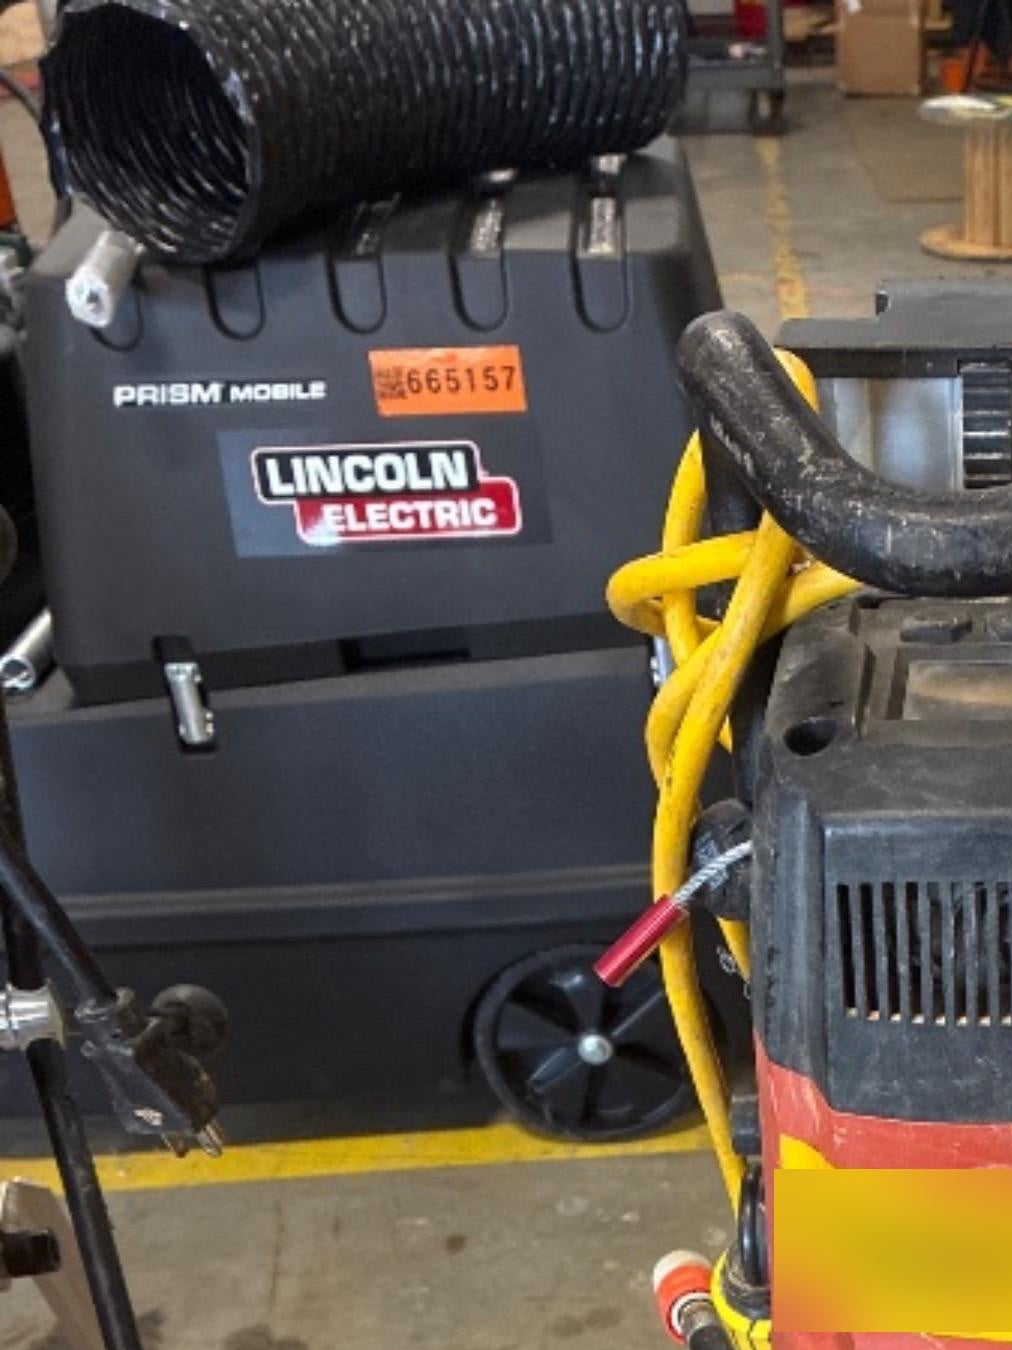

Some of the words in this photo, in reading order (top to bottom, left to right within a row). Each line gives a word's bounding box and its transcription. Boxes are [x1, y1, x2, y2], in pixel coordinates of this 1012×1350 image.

[113, 383, 222, 407] PRISM
[229, 381, 327, 402] MOBILE
[407, 364, 516, 395] 665157
[264, 450, 470, 495] LINCOLN
[320, 498, 498, 533] ELECTRIC
